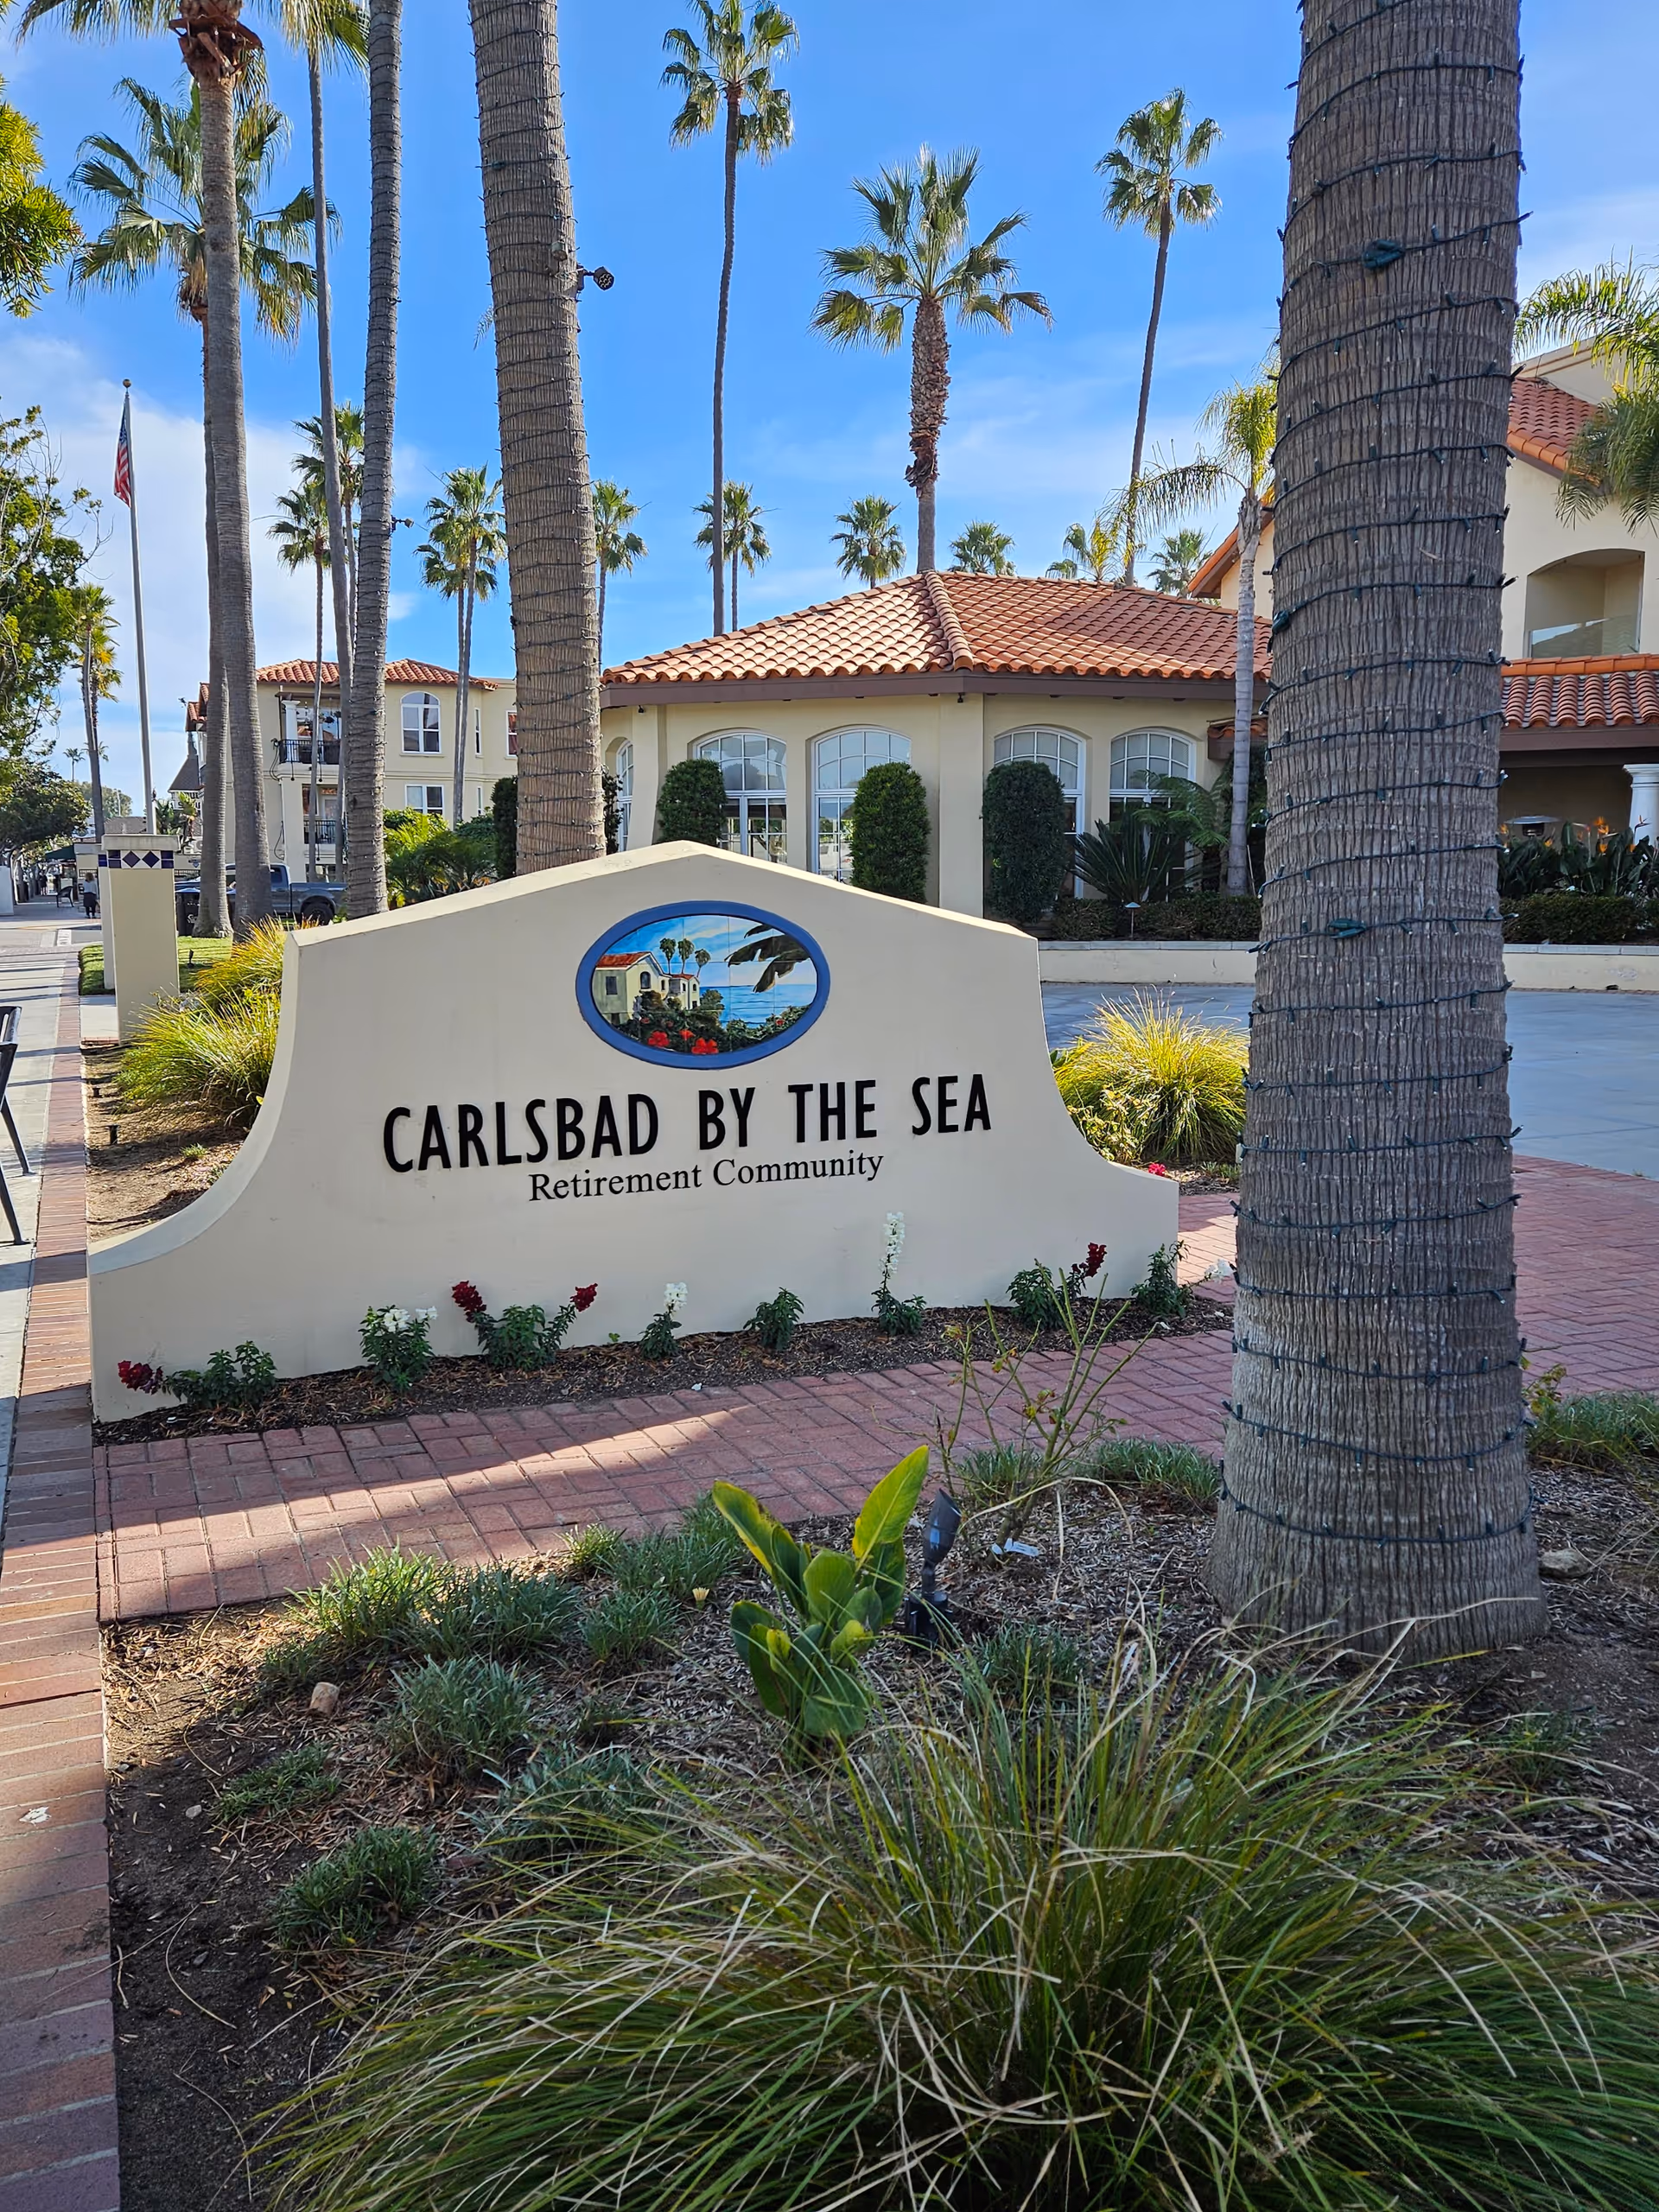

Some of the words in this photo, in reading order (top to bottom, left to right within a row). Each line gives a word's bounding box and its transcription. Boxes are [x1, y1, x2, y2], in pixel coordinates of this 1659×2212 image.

[383, 1093, 660, 1174] CARLSBAD
[698, 1086, 757, 1152] BY
[787, 1079, 878, 1143] THE
[912, 1073, 993, 1137] SEA
[528, 1164, 703, 1202] Retirement
[713, 1151, 885, 1187] Community
